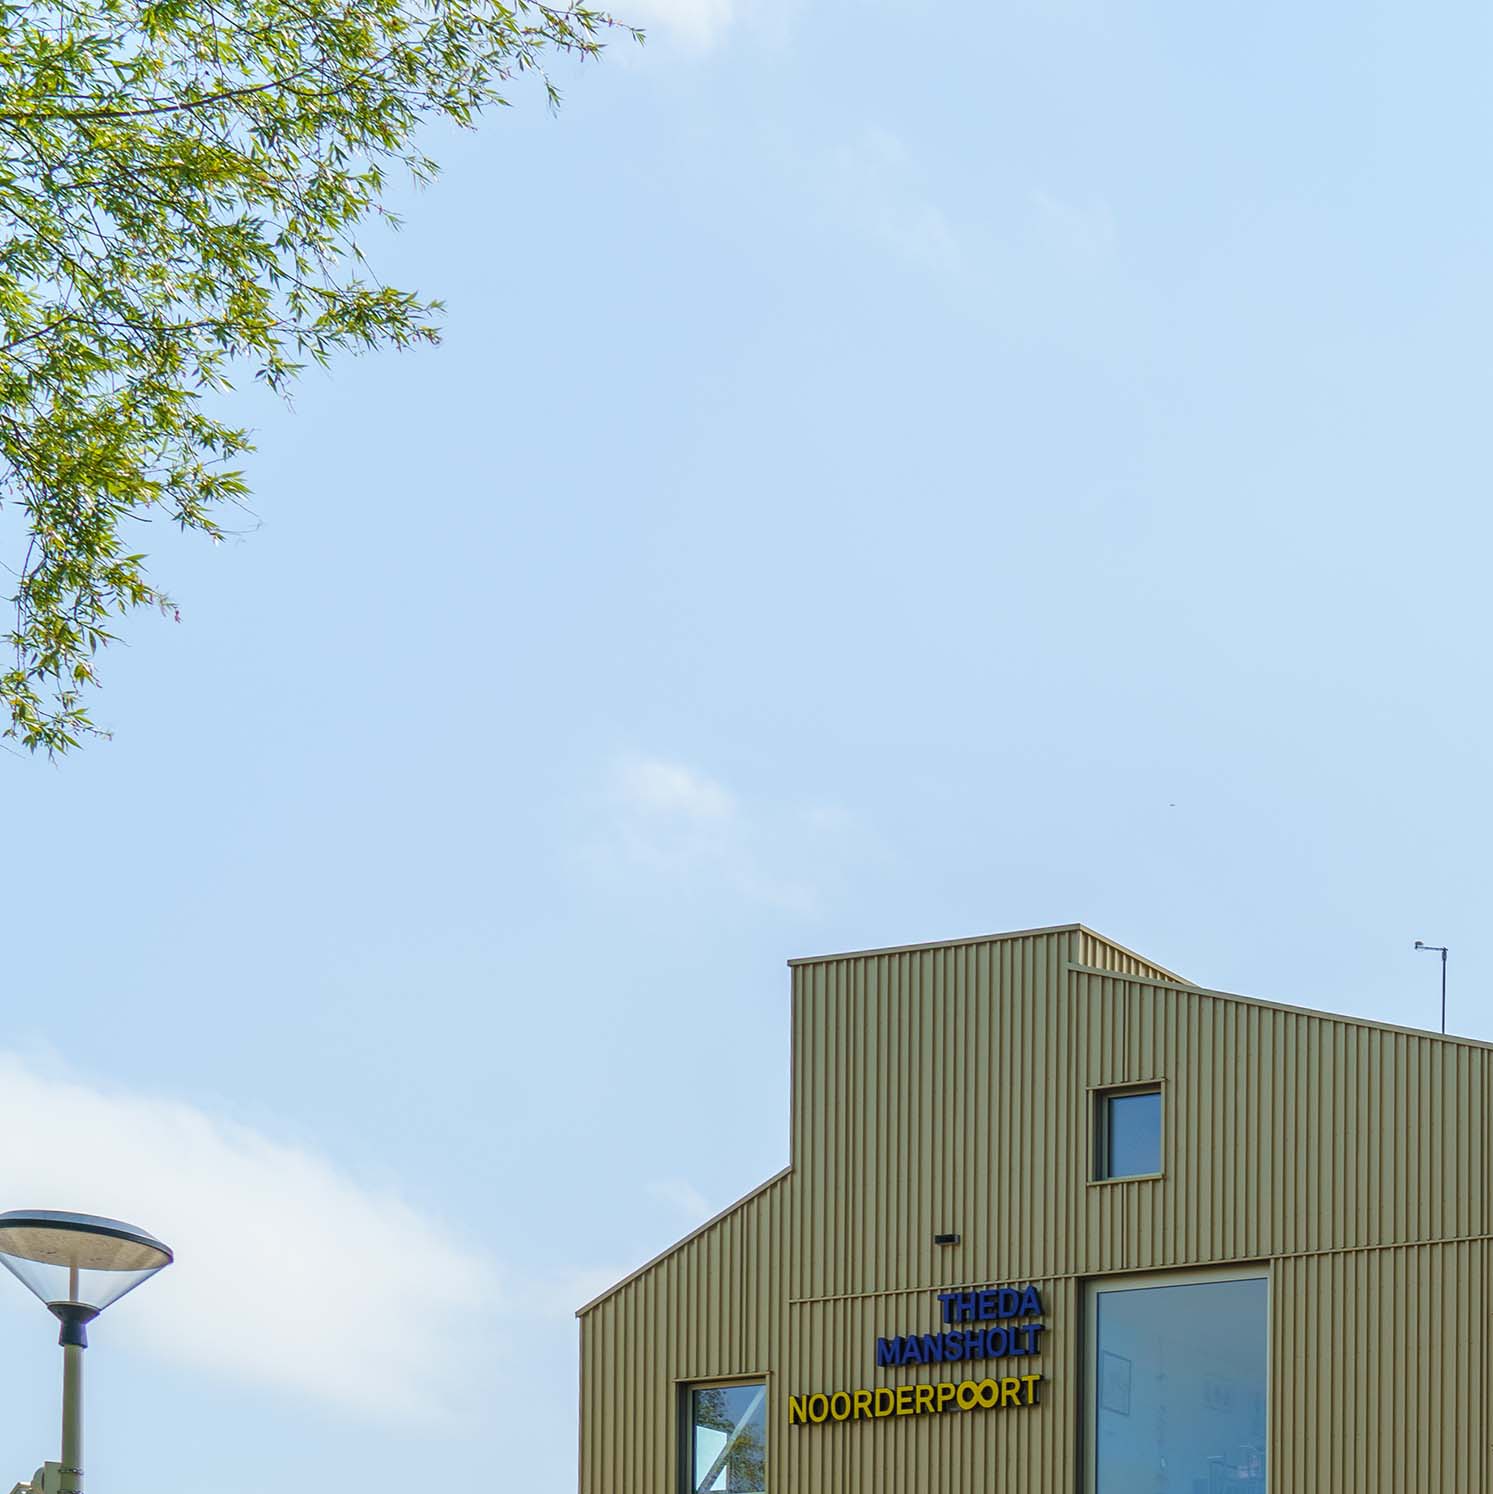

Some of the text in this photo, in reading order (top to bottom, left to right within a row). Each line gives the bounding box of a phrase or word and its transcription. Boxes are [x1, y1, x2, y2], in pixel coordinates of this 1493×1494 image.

[937, 1284, 1043, 1323] THEDA
[877, 1324, 1045, 1367] MANSHOLT
[789, 1374, 1042, 1425] NOORDERPOORT
